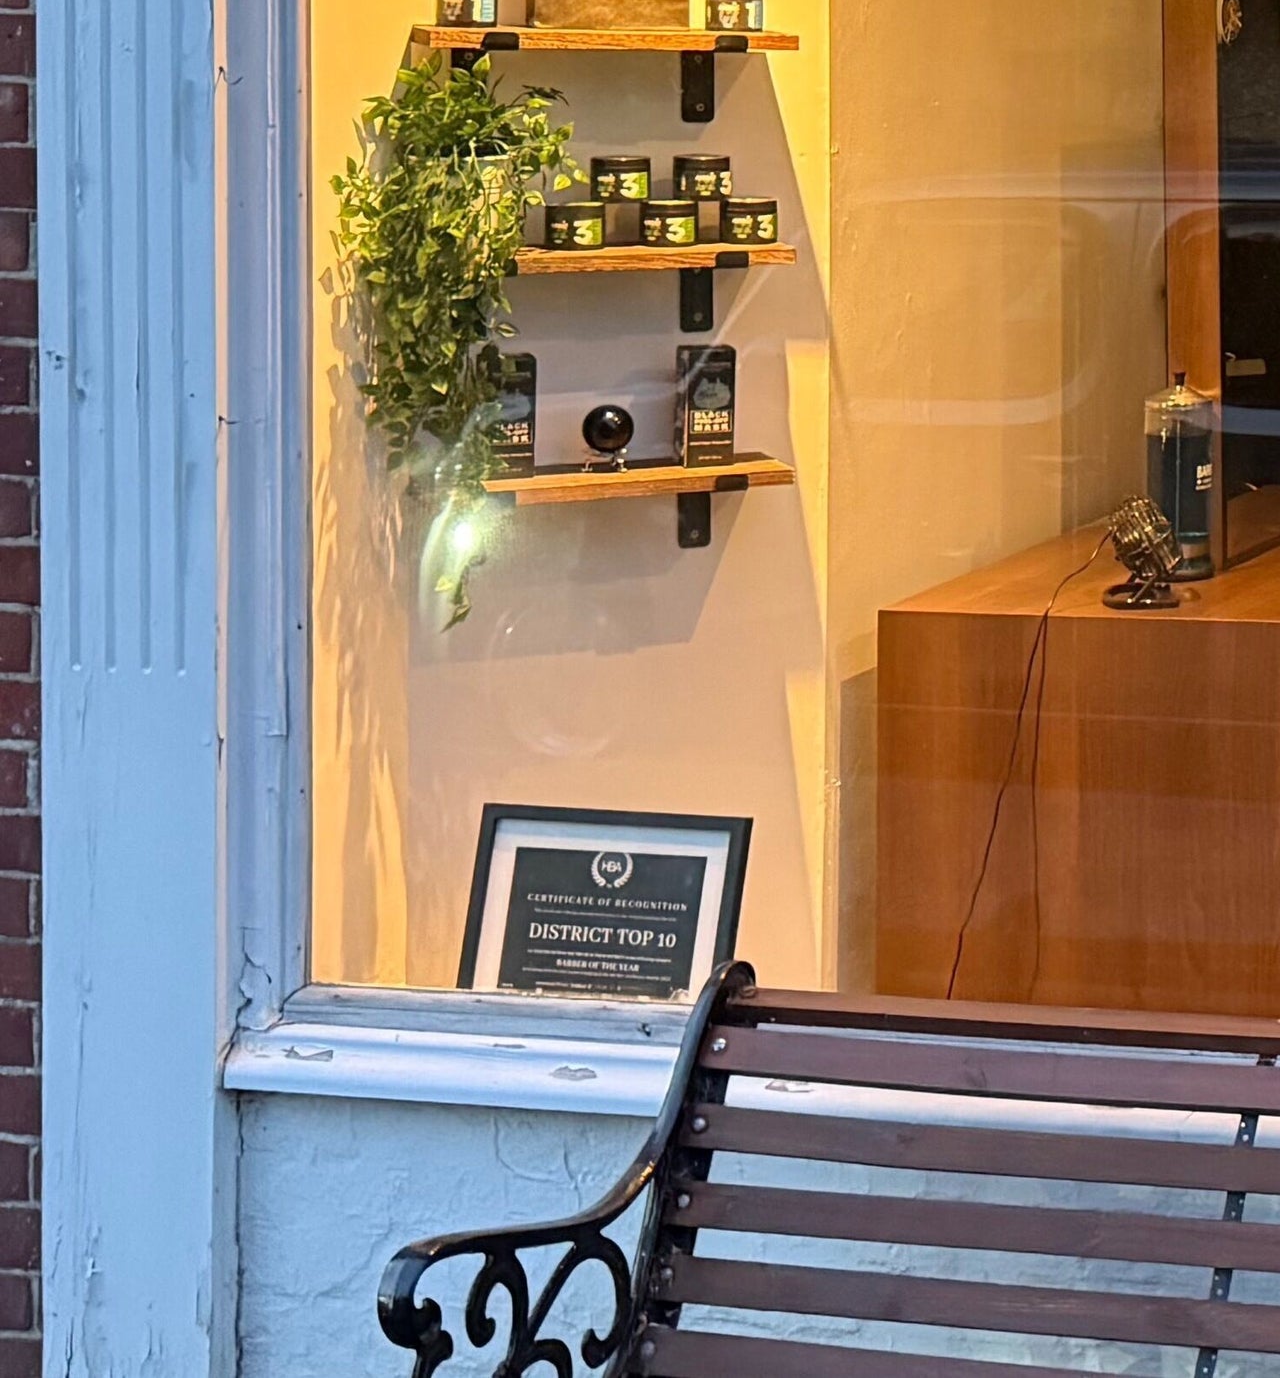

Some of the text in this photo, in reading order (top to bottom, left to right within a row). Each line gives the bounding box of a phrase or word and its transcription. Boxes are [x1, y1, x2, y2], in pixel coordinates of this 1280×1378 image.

[619, 173, 640, 199] 3
[719, 171, 732, 195] 3
[572, 219, 594, 245] 3
[665, 217, 686, 243] 3
[757, 214, 775, 240] 3
[693, 423, 729, 432] MASK
[694, 410, 729, 419] BLACK
[527, 892, 688, 912] CERTIFICATE OF RECOGNITION
[528, 922, 677, 949] DISTRICT TOP 10
